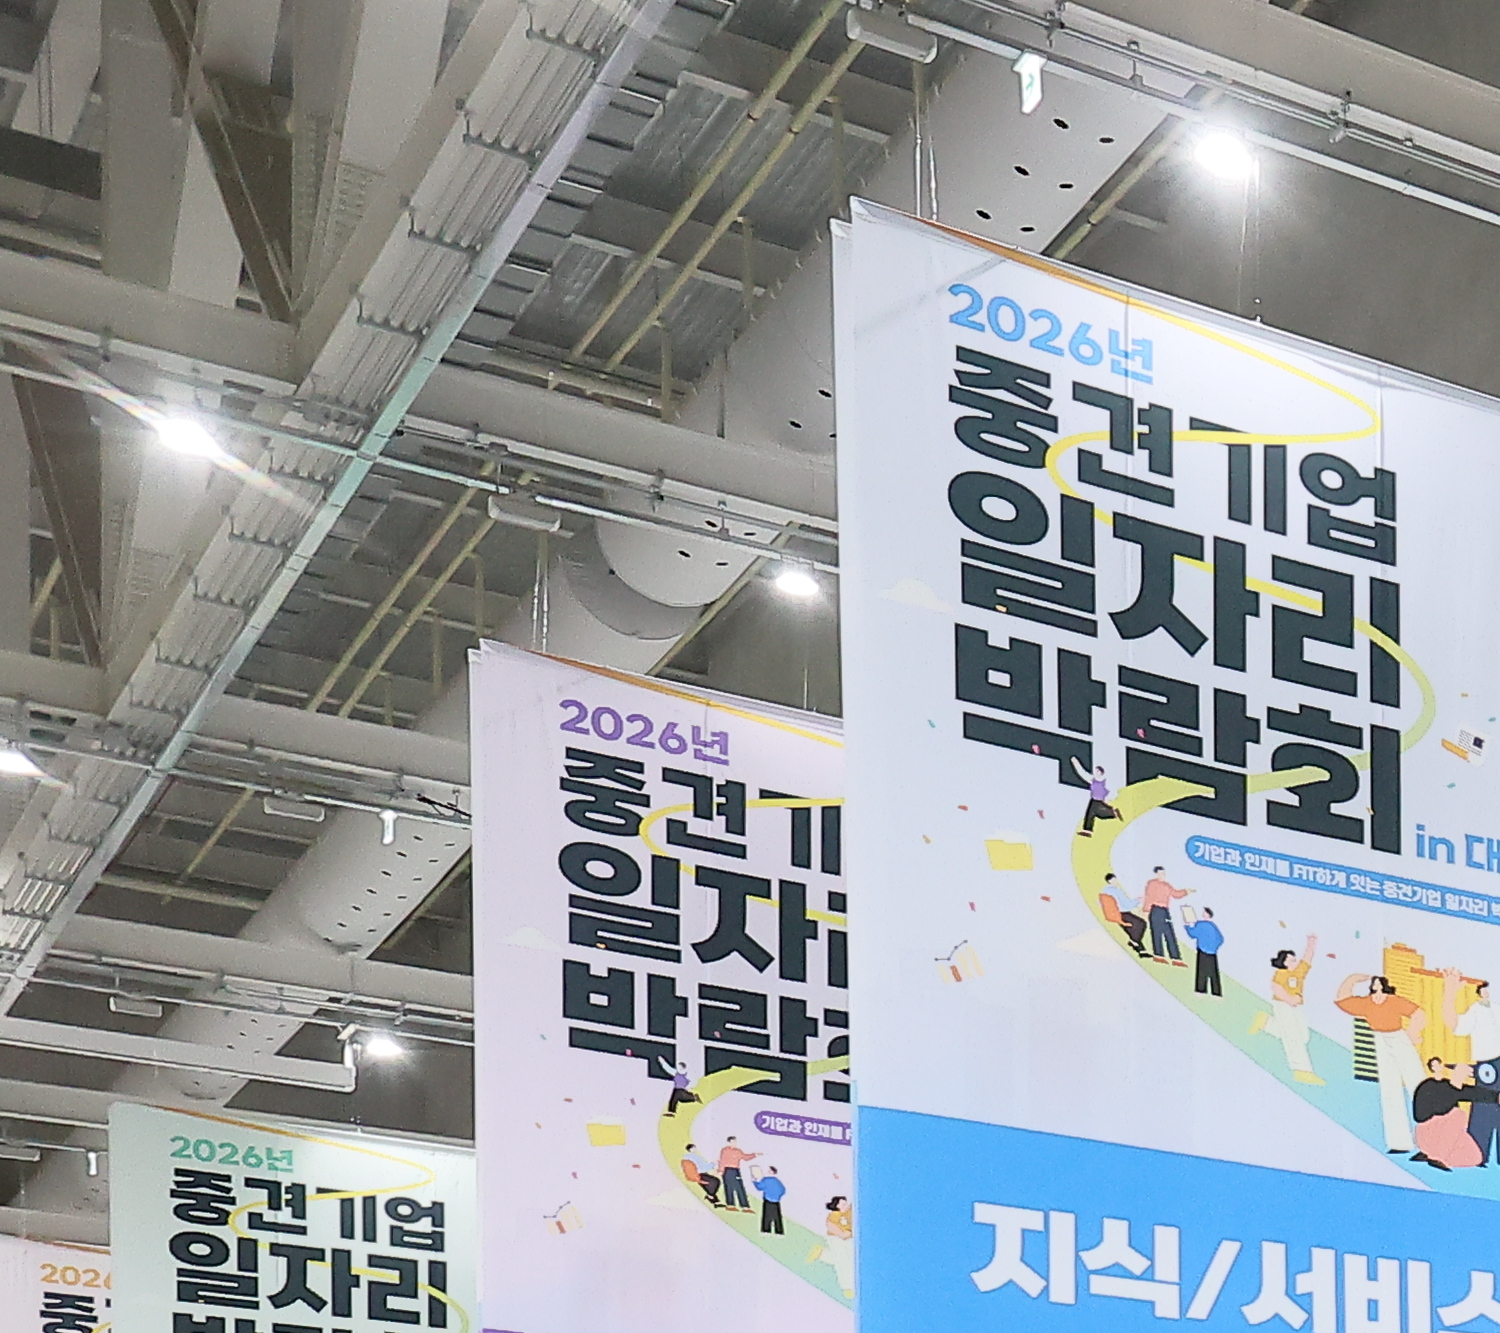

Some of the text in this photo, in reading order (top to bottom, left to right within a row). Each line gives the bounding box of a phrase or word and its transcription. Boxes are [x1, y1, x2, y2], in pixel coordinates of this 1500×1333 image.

[947, 282, 1154, 385] 2026년
[946, 345, 1398, 567] 중견기업
[946, 470, 1402, 708] 일자리
[559, 698, 730, 768] 2026년
[953, 623, 1403, 855] 박람회
[1415, 824, 1455, 864] in
[556, 746, 844, 880] 중견기
[169, 1135, 294, 1173] 2026년
[169, 1167, 445, 1252] 중견기업
[168, 1230, 447, 1328] 일자리
